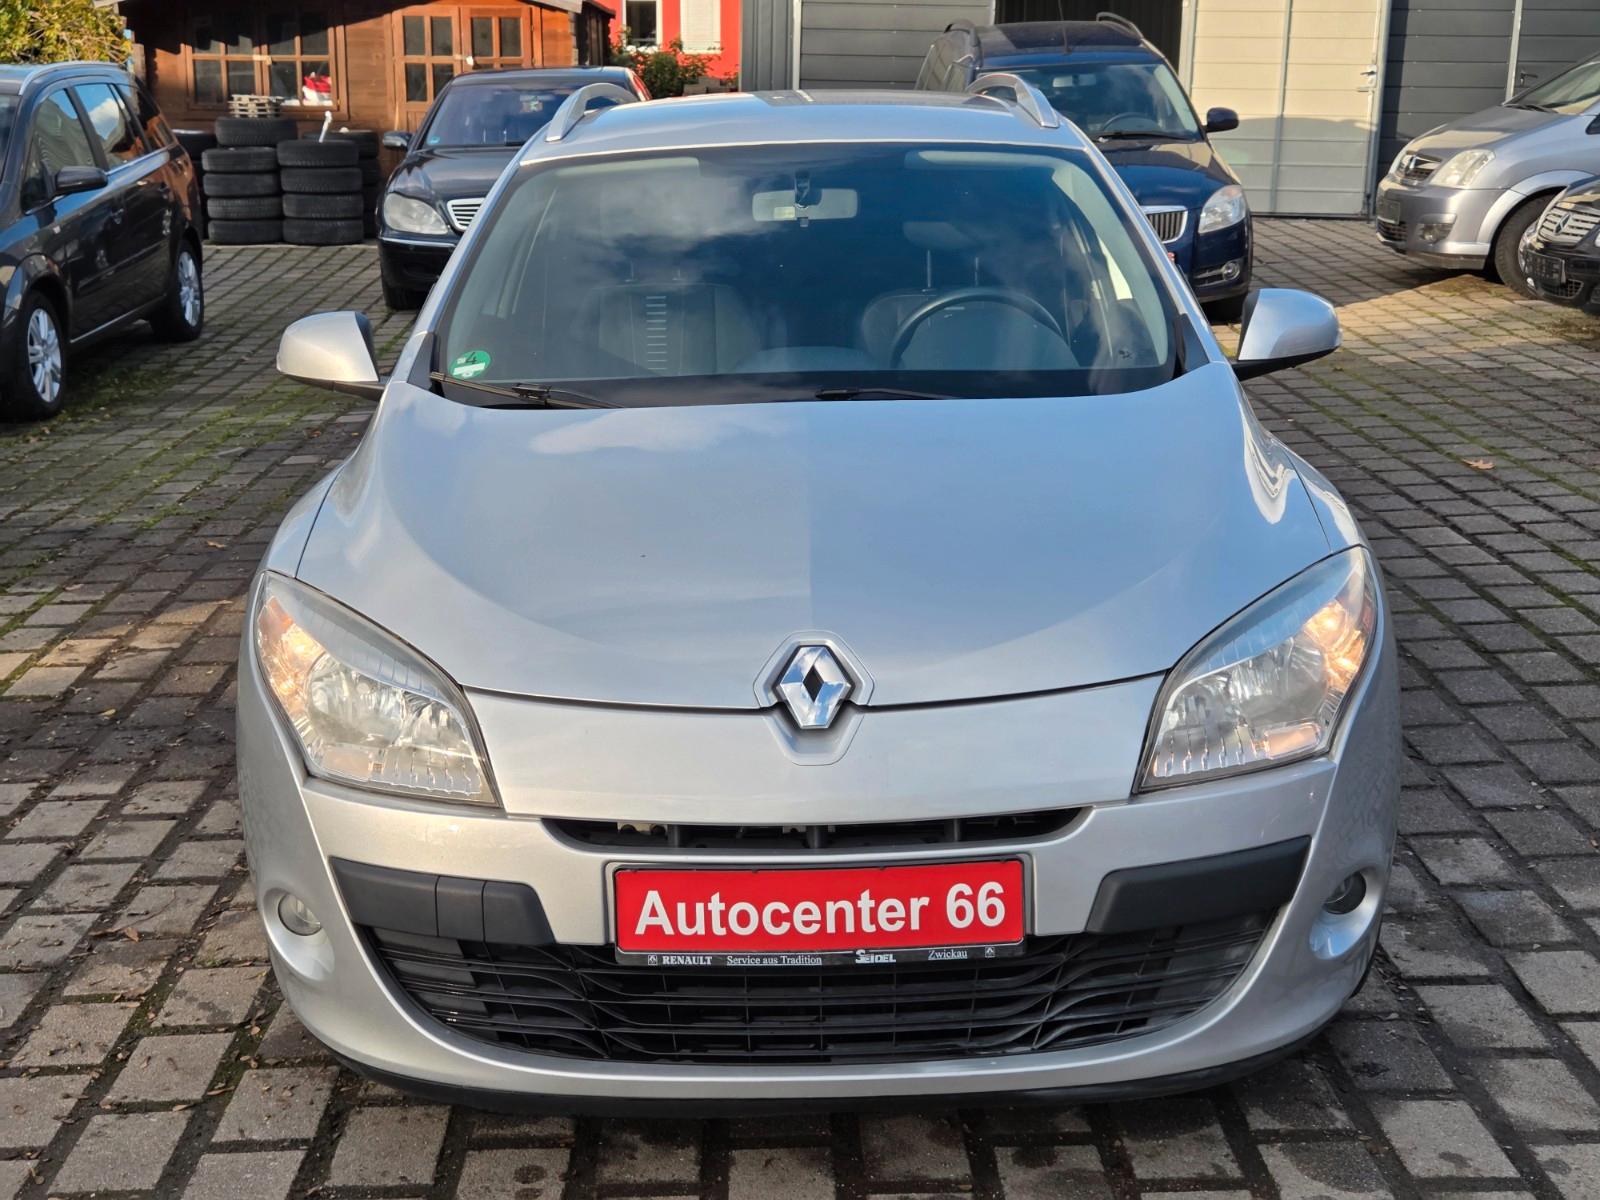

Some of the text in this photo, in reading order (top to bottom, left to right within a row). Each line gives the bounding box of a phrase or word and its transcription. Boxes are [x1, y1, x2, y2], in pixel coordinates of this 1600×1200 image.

[634, 881, 1006, 936] Autocenter 66
[662, 955, 713, 965] RENAULT
[726, 954, 822, 965] Service aus Tradition
[928, 949, 968, 960] Zwickau
